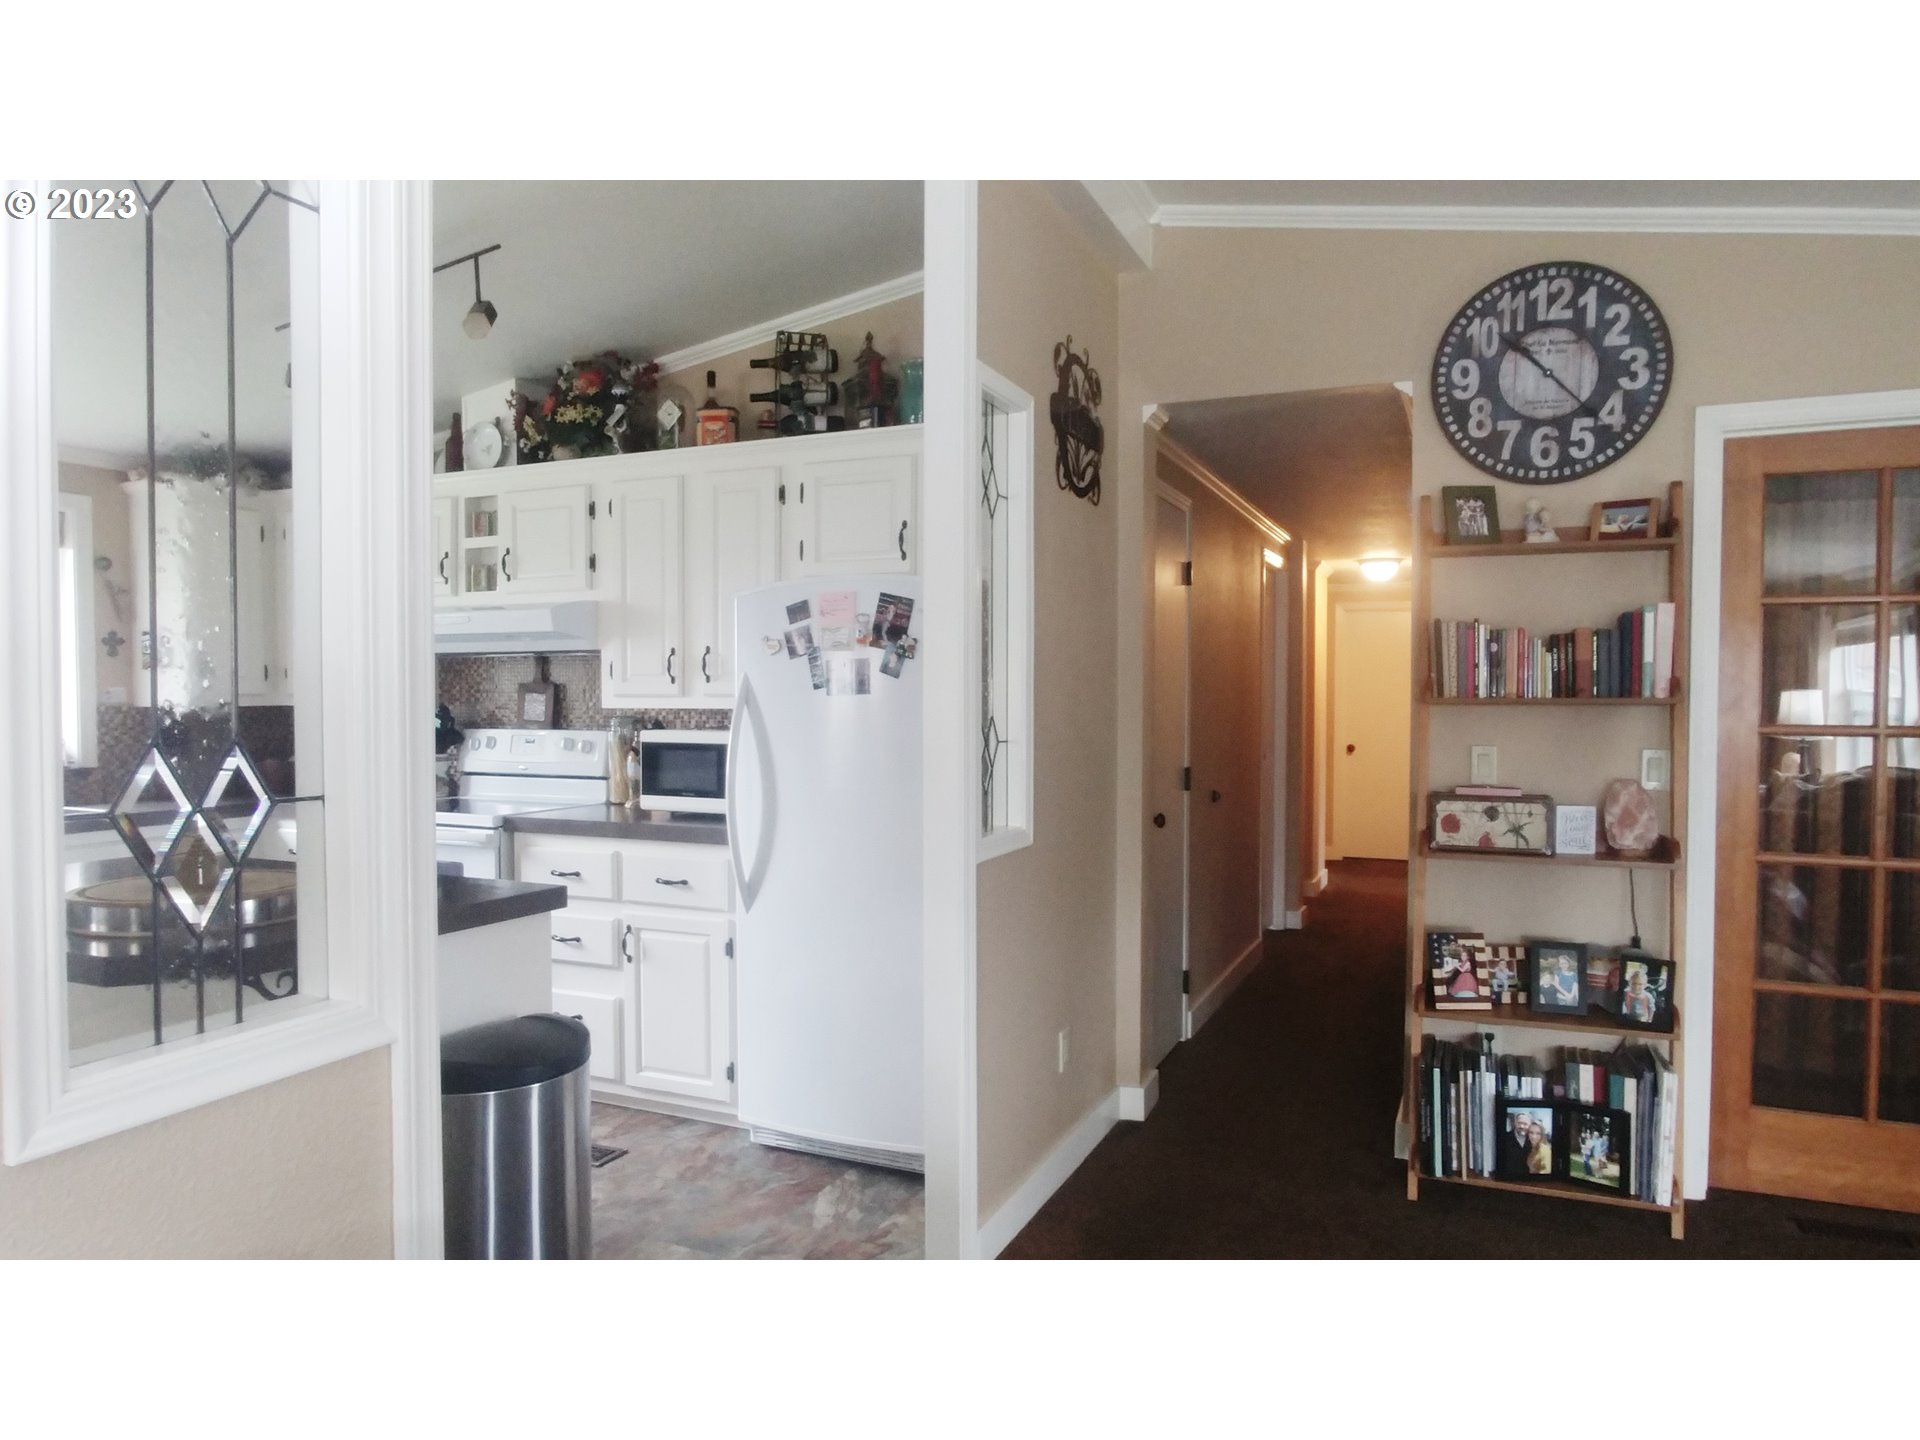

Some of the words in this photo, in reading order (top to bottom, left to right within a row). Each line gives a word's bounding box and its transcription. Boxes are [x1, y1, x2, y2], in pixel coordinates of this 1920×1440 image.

[1497, 290, 1526, 333] 11
[1528, 278, 1574, 321] 12
[1578, 286, 1597, 329] 1
[1466, 316, 1499, 359] 10
[1602, 303, 1631, 347] 2
[1451, 358, 1480, 400] 9
[1617, 347, 1650, 390] 3
[1468, 397, 1492, 438] 8
[1598, 389, 1626, 432] 4
[1497, 420, 1522, 460] 7
[1530, 426, 1559, 468] 6
[1568, 417, 1595, 459] 5
